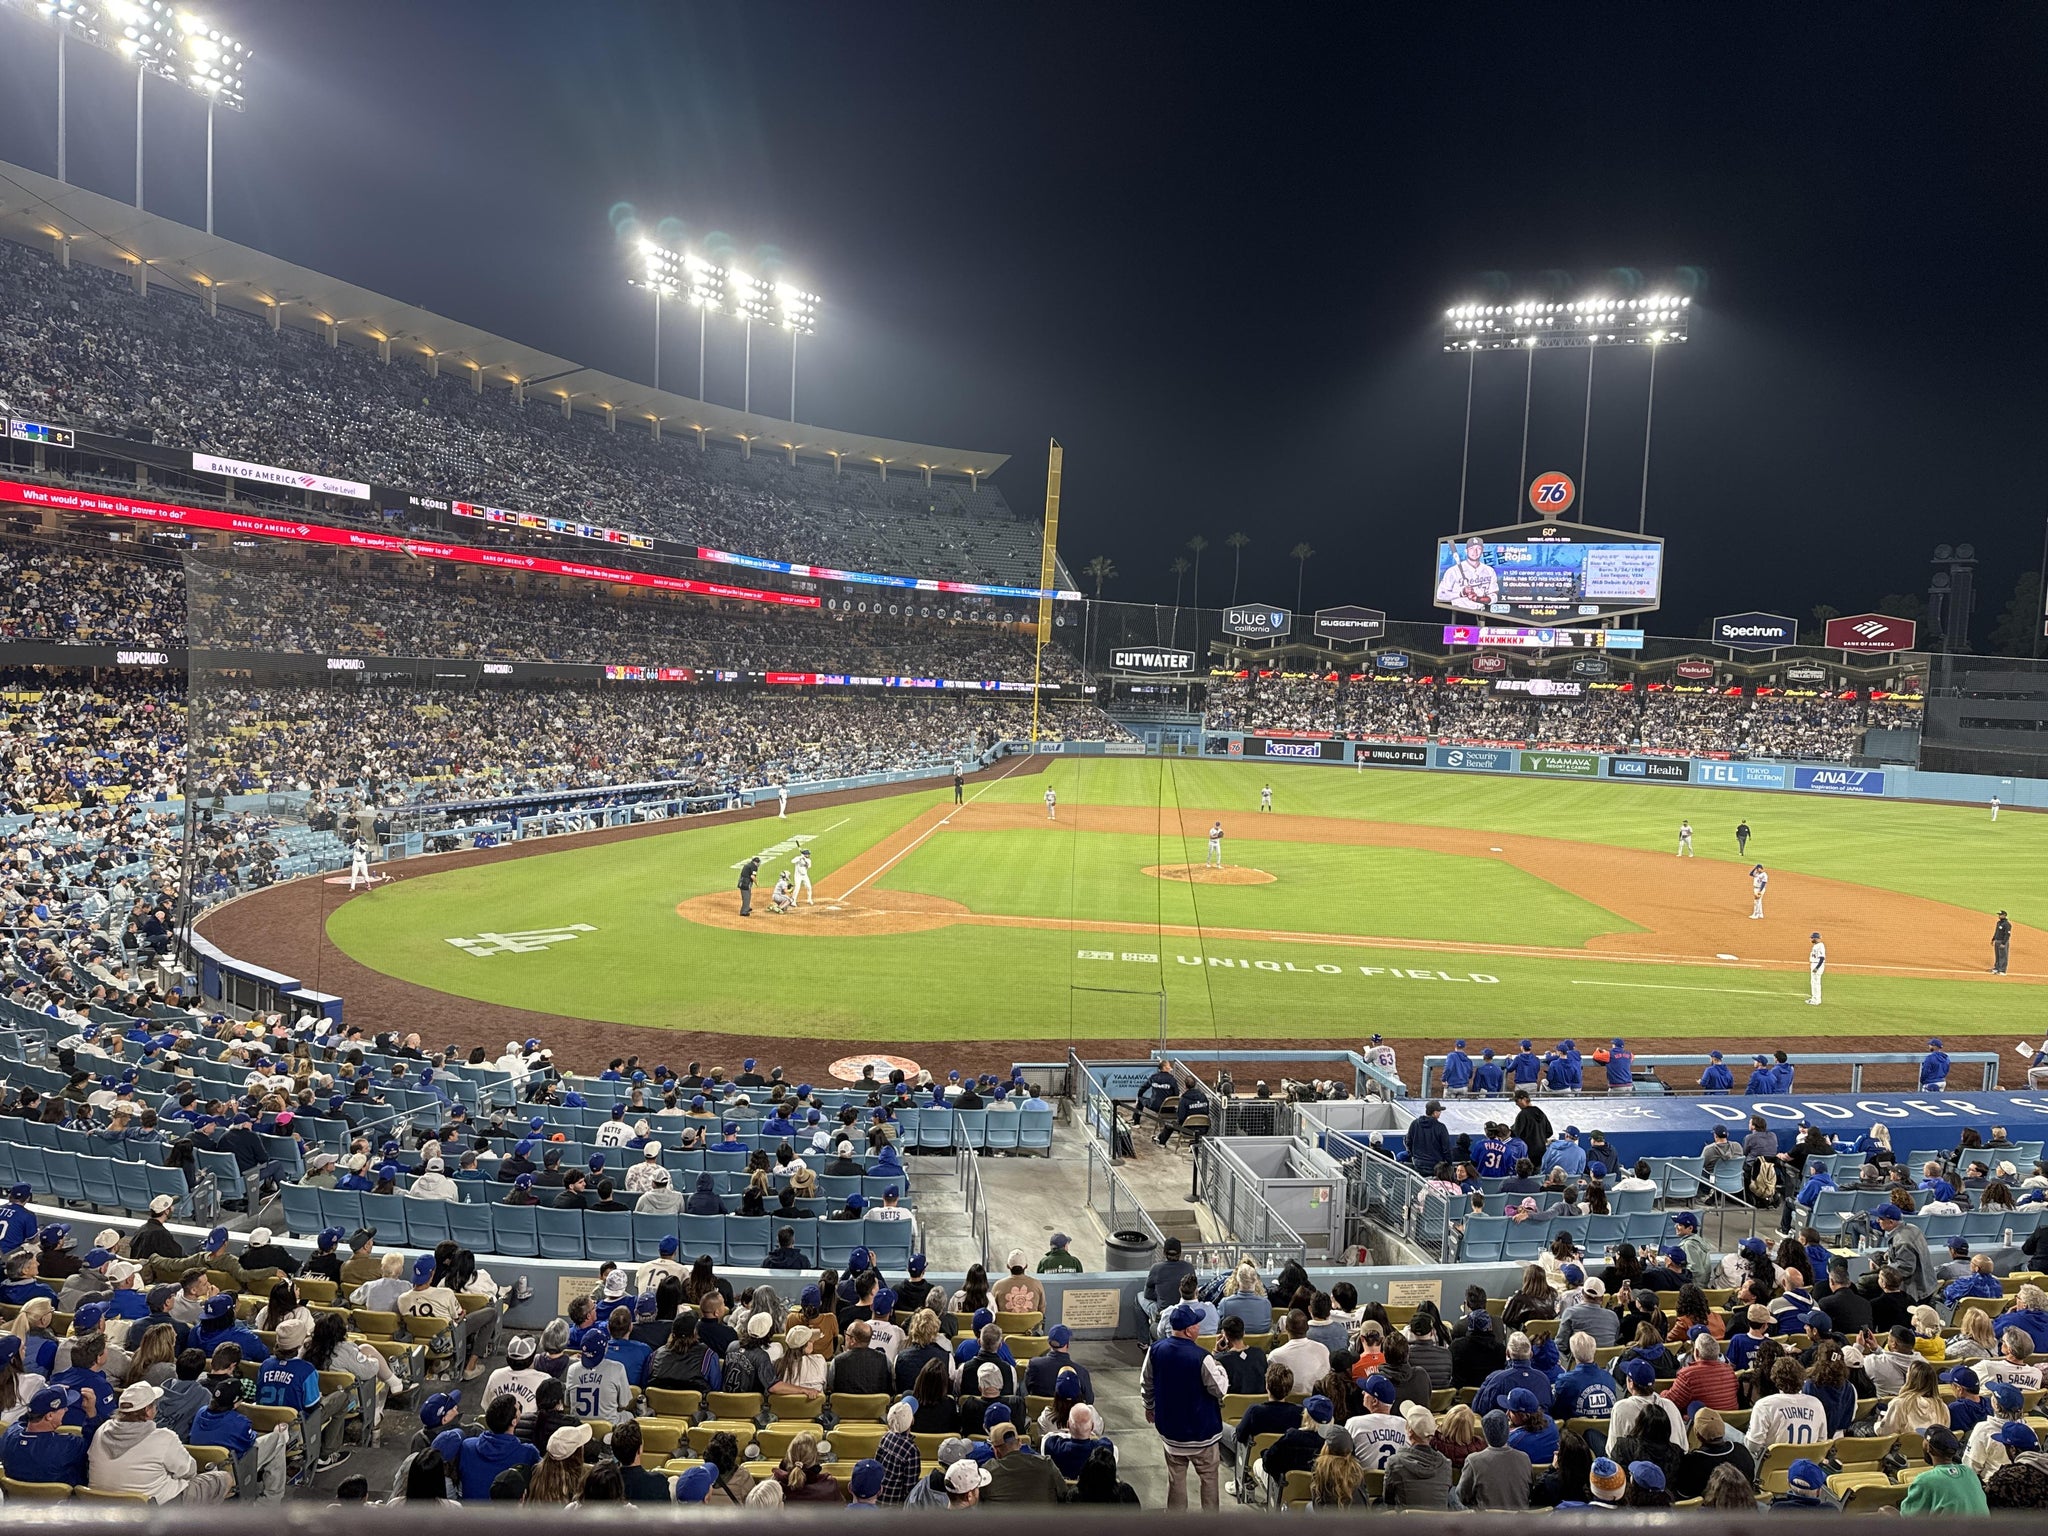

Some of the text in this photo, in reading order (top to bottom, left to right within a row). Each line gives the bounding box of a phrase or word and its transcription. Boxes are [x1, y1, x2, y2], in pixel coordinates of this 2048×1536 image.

[12, 430, 28, 440] ATH
[56, 432, 62, 442] 8
[212, 463, 297, 485] BANK OF AMERICA
[322, 483, 356, 495] Suite Level
[1538, 482, 1566, 504] 76
[23, 490, 184, 520] What would you like the power to do?
[410, 496, 420, 505] NL
[422, 498, 448, 511] SCORES
[232, 520, 296, 534] BANK OF AMERICA
[350, 535, 366, 544] What
[366, 537, 384, 546] would
[418, 546, 434, 554] power
[1504, 553, 1532, 562] Rojas
[1230, 610, 1266, 625] blue
[1320, 620, 1379, 628] GUGGENHEIM
[1722, 625, 1783, 638] Spectrum
[116, 651, 160, 664] SNAPCHAT
[1116, 652, 1188, 668] CUTWATER
[1478, 659, 1500, 668] JINRO
[327, 658, 359, 670] SNAPCHAT
[484, 664, 508, 674] SNAPCHAT
[1680, 666, 1711, 674] Yakult
[1495, 680, 1534, 690] IBEW
[1549, 682, 1582, 691] NECA
[1042, 744, 1056, 752] ANA
[1230, 744, 1240, 752] 76
[1265, 740, 1321, 757] kanzai
[1372, 751, 1424, 760] UNIQLO FIELD
[1466, 750, 1498, 762] Security
[1466, 760, 1494, 768] Benefit
[1618, 764, 1683, 776] UCLA Health
[1702, 766, 1739, 782] TEL
[1747, 774, 1782, 782] ELECTRON
[1812, 772, 1846, 784] ANA
[1176, 954, 1342, 980] UNIQLO
[1360, 966, 1500, 990] FIELD
[1379, 1054, 1394, 1066] 63
[1152, 1082, 1171, 1090] SECURITY
[1188, 1102, 1208, 1110] SECURITY
[1696, 1098, 2048, 1120] DODGER S
[604, 1126, 622, 1134] BETTS
[602, 1134, 619, 1146] 50
[1484, 1142, 1506, 1153] PIAZZA
[1484, 1153, 1502, 1169] 31
[0, 1208, 16, 1218] TTS
[880, 1210, 900, 1220] BETTS
[1734, 1262, 1751, 1271] 大谷
[1341, 1320, 1360, 1330] OHTA
[872, 1330, 892, 1344] SHAW
[264, 1370, 294, 1386] FERRIS
[578, 1372, 603, 1385] VESIA
[2008, 1374, 2038, 1388] SASAKI
[260, 1386, 286, 1406] 21
[494, 1382, 536, 1403] YAMAMOTO
[576, 1387, 600, 1417] 51
[1590, 1396, 1606, 1406] LAD
[1780, 1406, 1814, 1421] TURNER
[1366, 1428, 1406, 1446] LASORDA
[1787, 1423, 1812, 1444] 10
[1378, 1444, 1396, 1470] 2
